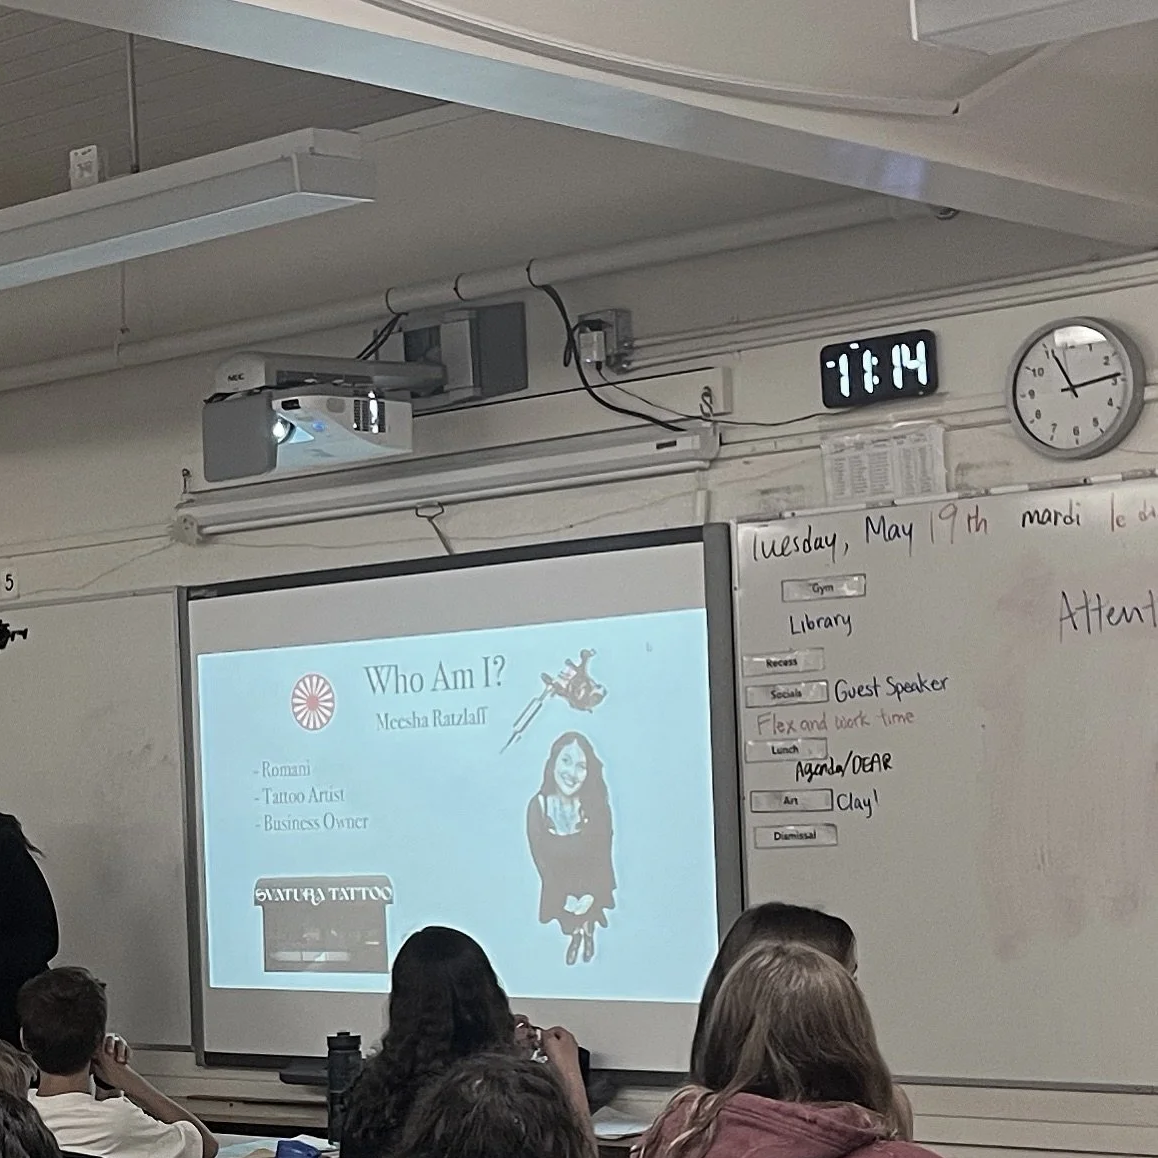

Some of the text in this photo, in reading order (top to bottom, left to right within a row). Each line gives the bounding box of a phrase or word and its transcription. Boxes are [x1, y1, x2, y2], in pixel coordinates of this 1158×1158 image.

[839, 341, 928, 397] 11:14
[865, 515, 913, 557] May
[1021, 498, 1081, 528] mardi
[1111, 492, 1127, 532] le
[5, 574, 14, 592] 5
[812, 583, 834, 596] Gym
[789, 613, 852, 638] Library
[766, 658, 798, 668] Recess
[363, 654, 506, 696] Who Am I?
[834, 672, 950, 703] Guest Speaker
[376, 706, 489, 731] Meesha Ratzlaff
[757, 711, 796, 736] Flex
[801, 712, 828, 732] and
[876, 708, 915, 726] time
[770, 745, 800, 756] Lunch
[262, 760, 311, 778] Romani
[262, 785, 346, 805] Tattoo Artist
[783, 796, 798, 806] Art
[836, 789, 879, 818] Clay!
[264, 812, 370, 832] Business Owner
[774, 830, 816, 842] Dismissal
[328, 886, 392, 901] TATTOO
